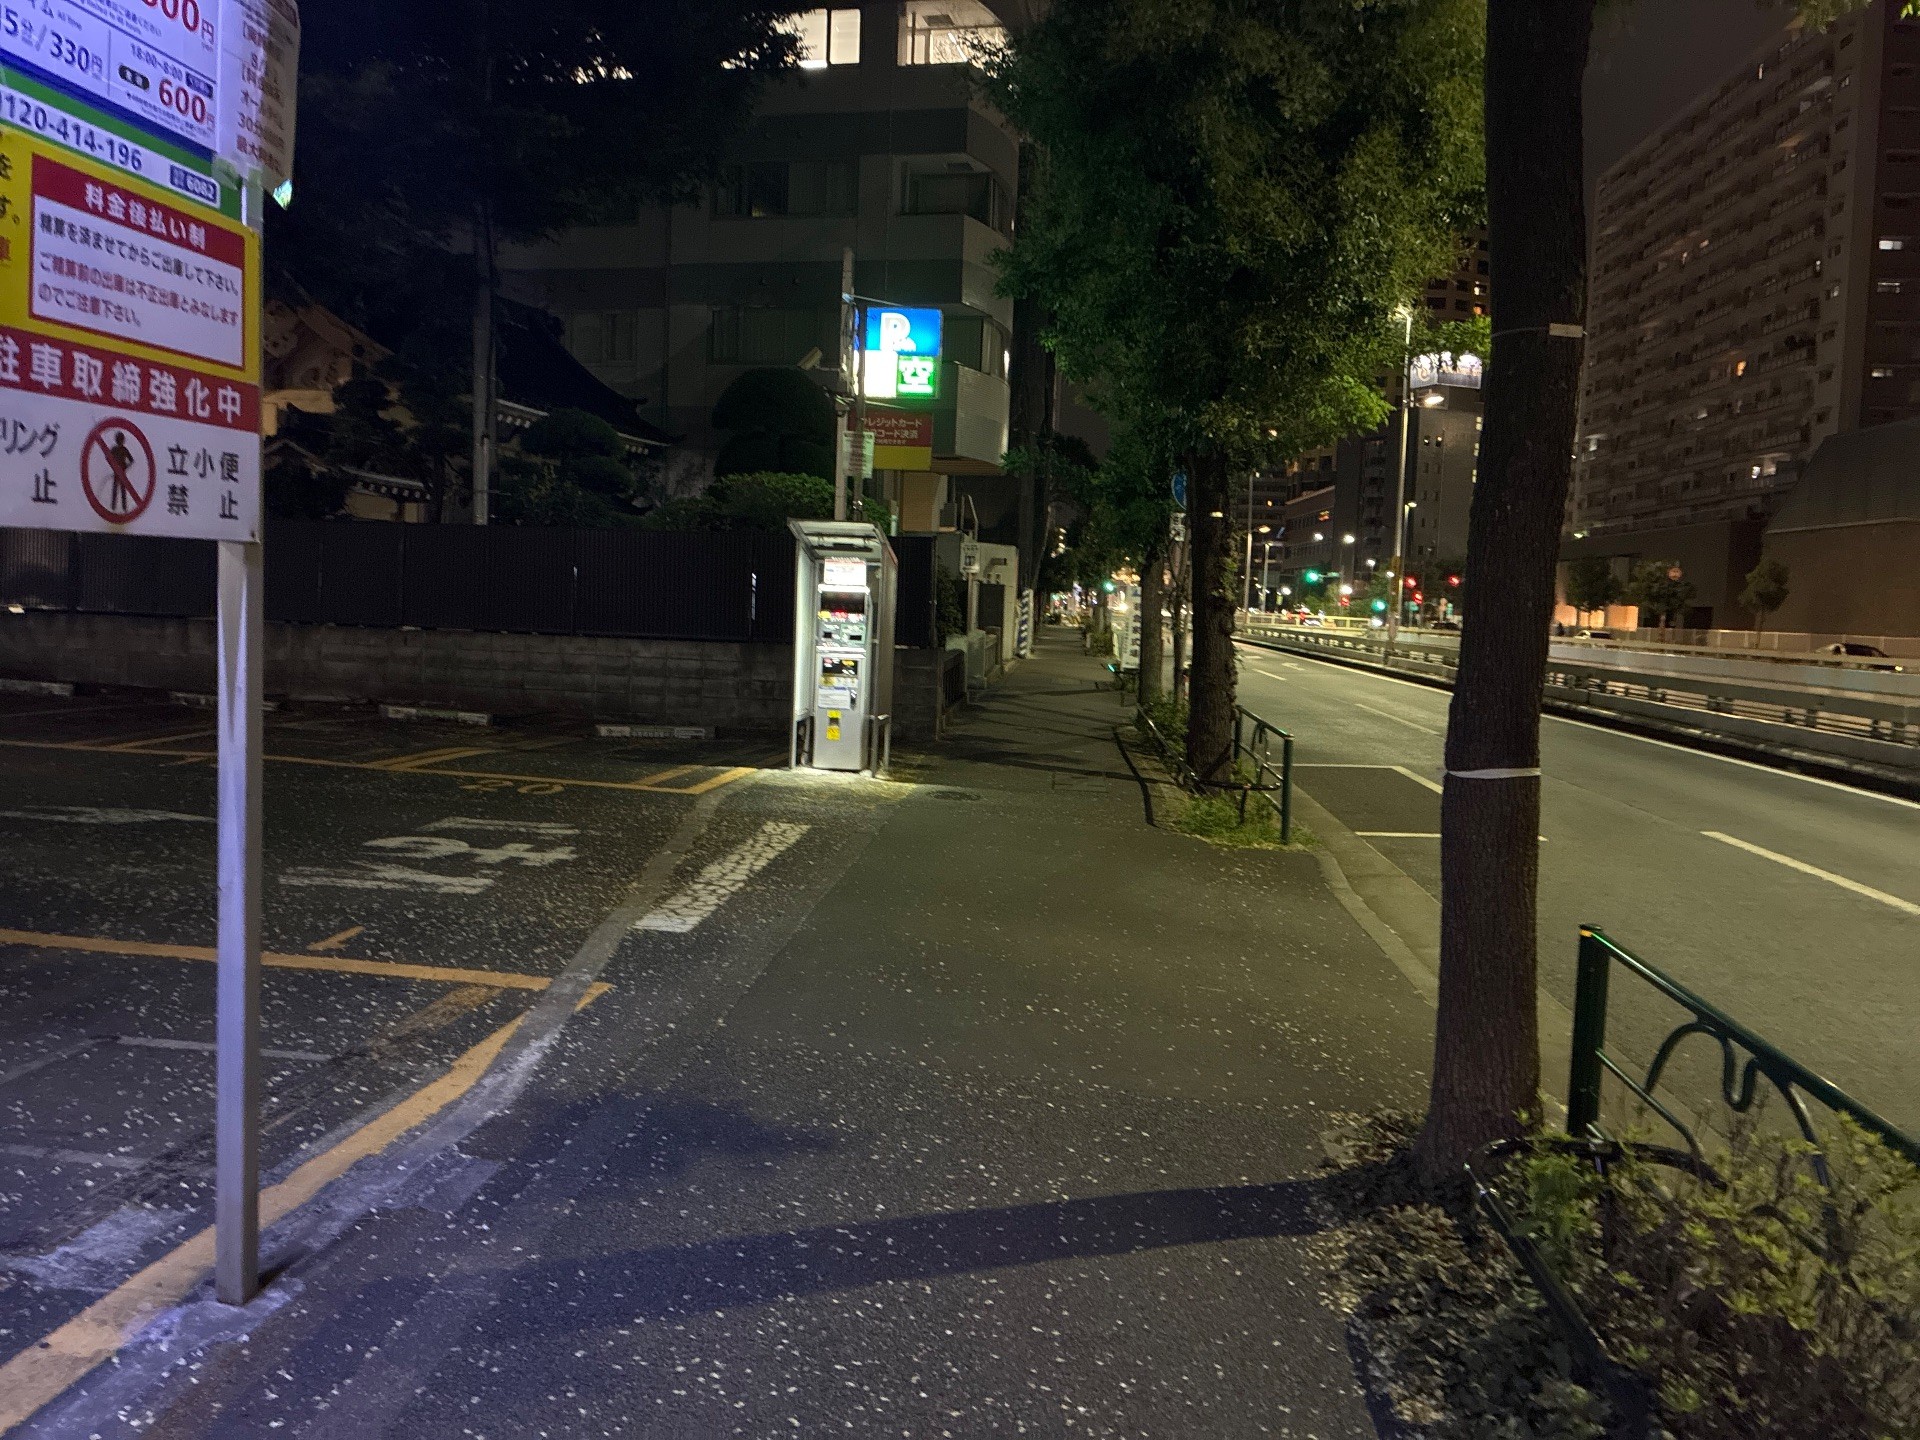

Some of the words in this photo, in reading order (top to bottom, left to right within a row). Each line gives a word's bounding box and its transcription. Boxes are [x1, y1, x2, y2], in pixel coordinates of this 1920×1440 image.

[0, 89, 143, 172] 120-414-196
[167, 443, 240, 484] 立小便
[31, 468, 58, 505] 止
